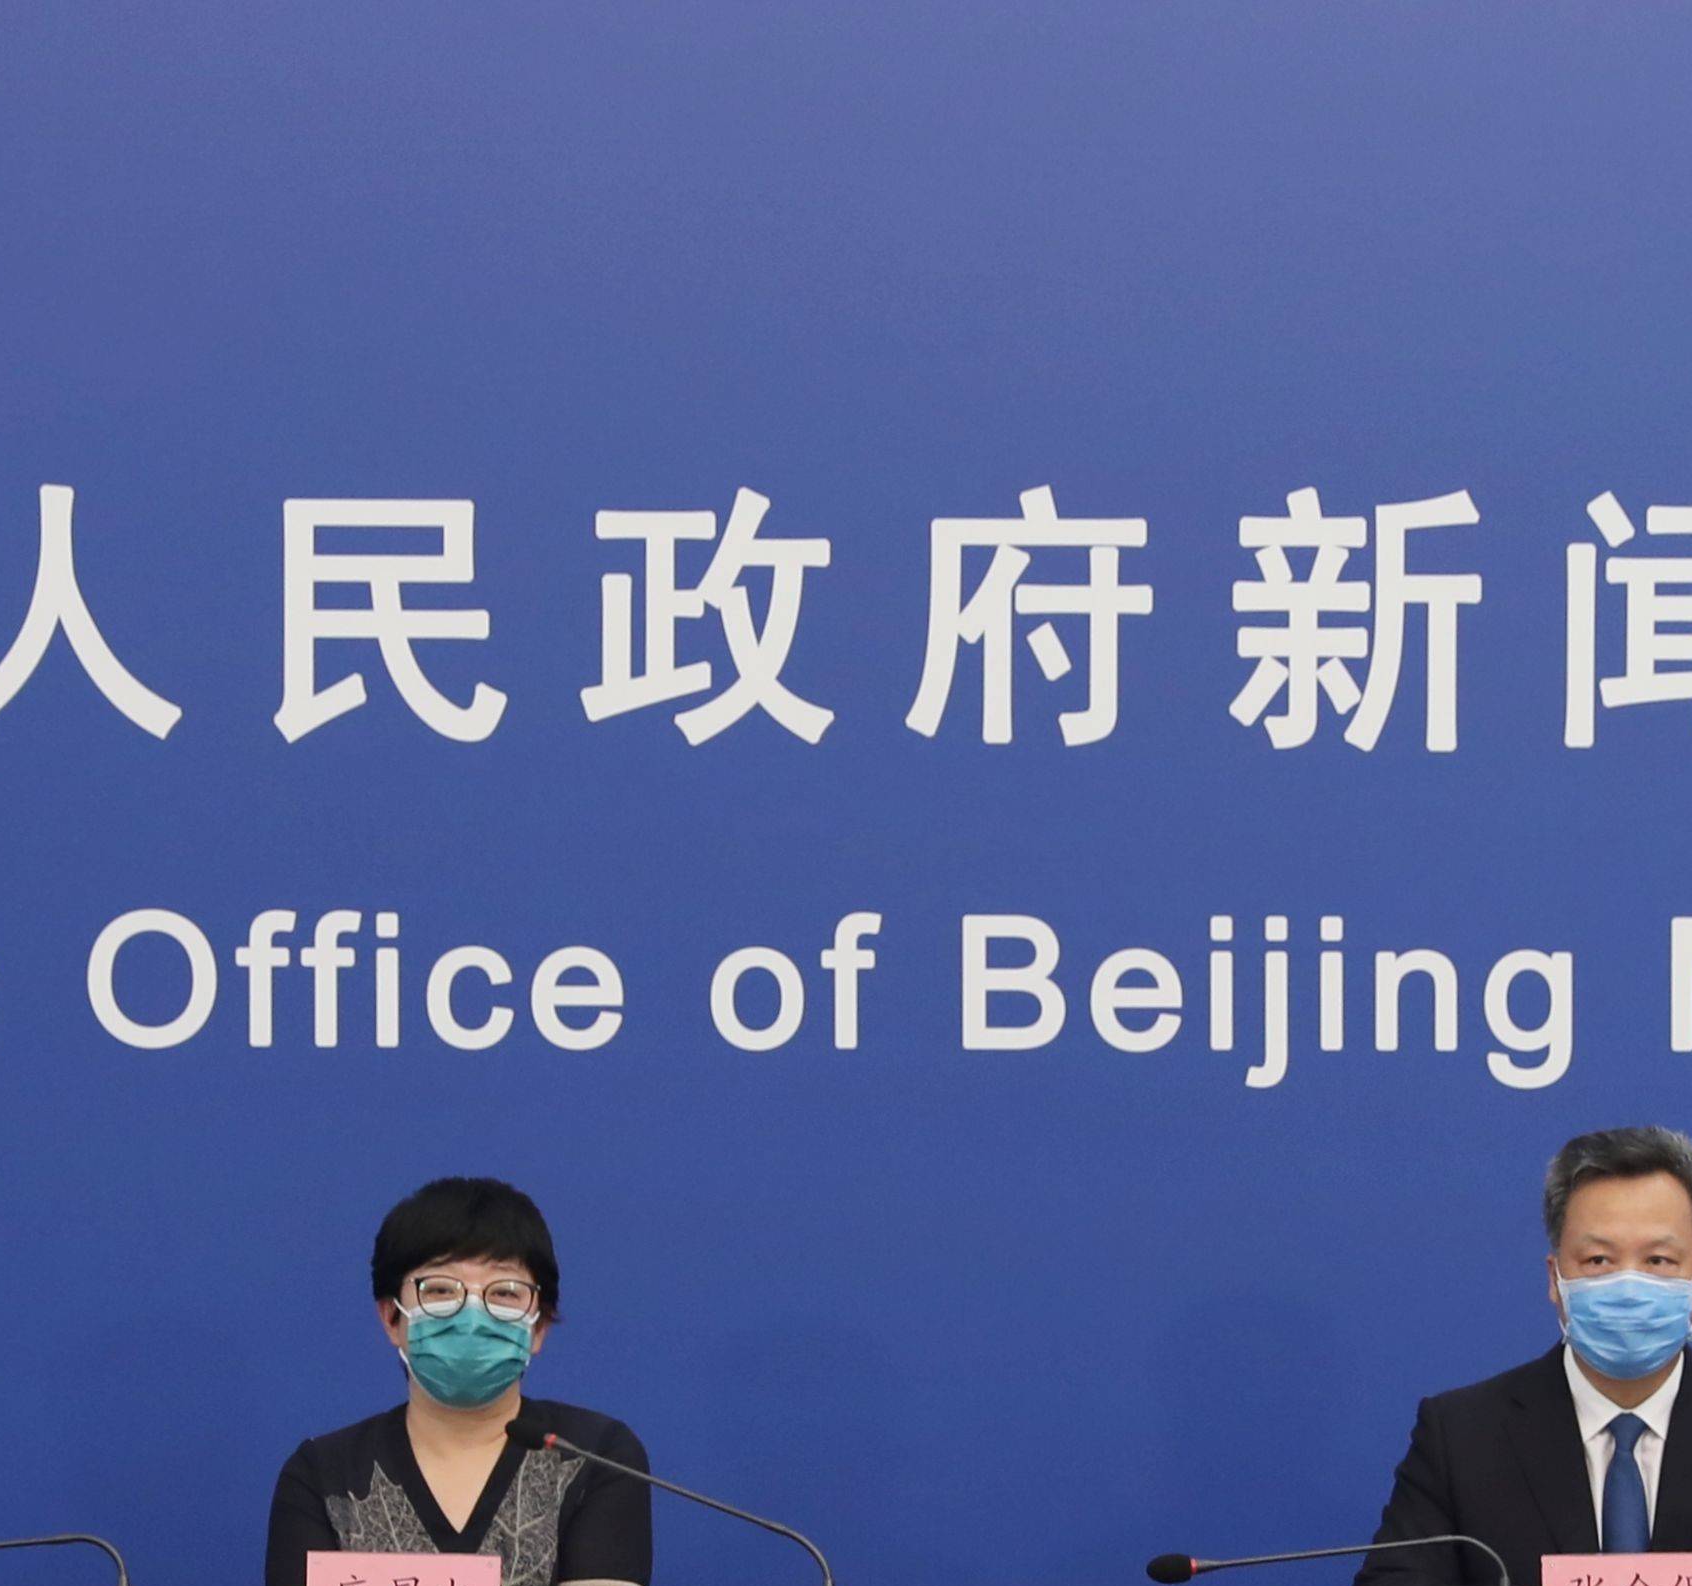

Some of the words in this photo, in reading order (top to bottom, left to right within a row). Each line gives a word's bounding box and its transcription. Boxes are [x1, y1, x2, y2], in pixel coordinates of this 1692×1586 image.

[86, 907, 624, 1051] Office
[709, 910, 882, 1051] of
[961, 913, 1573, 1089] Beijing
